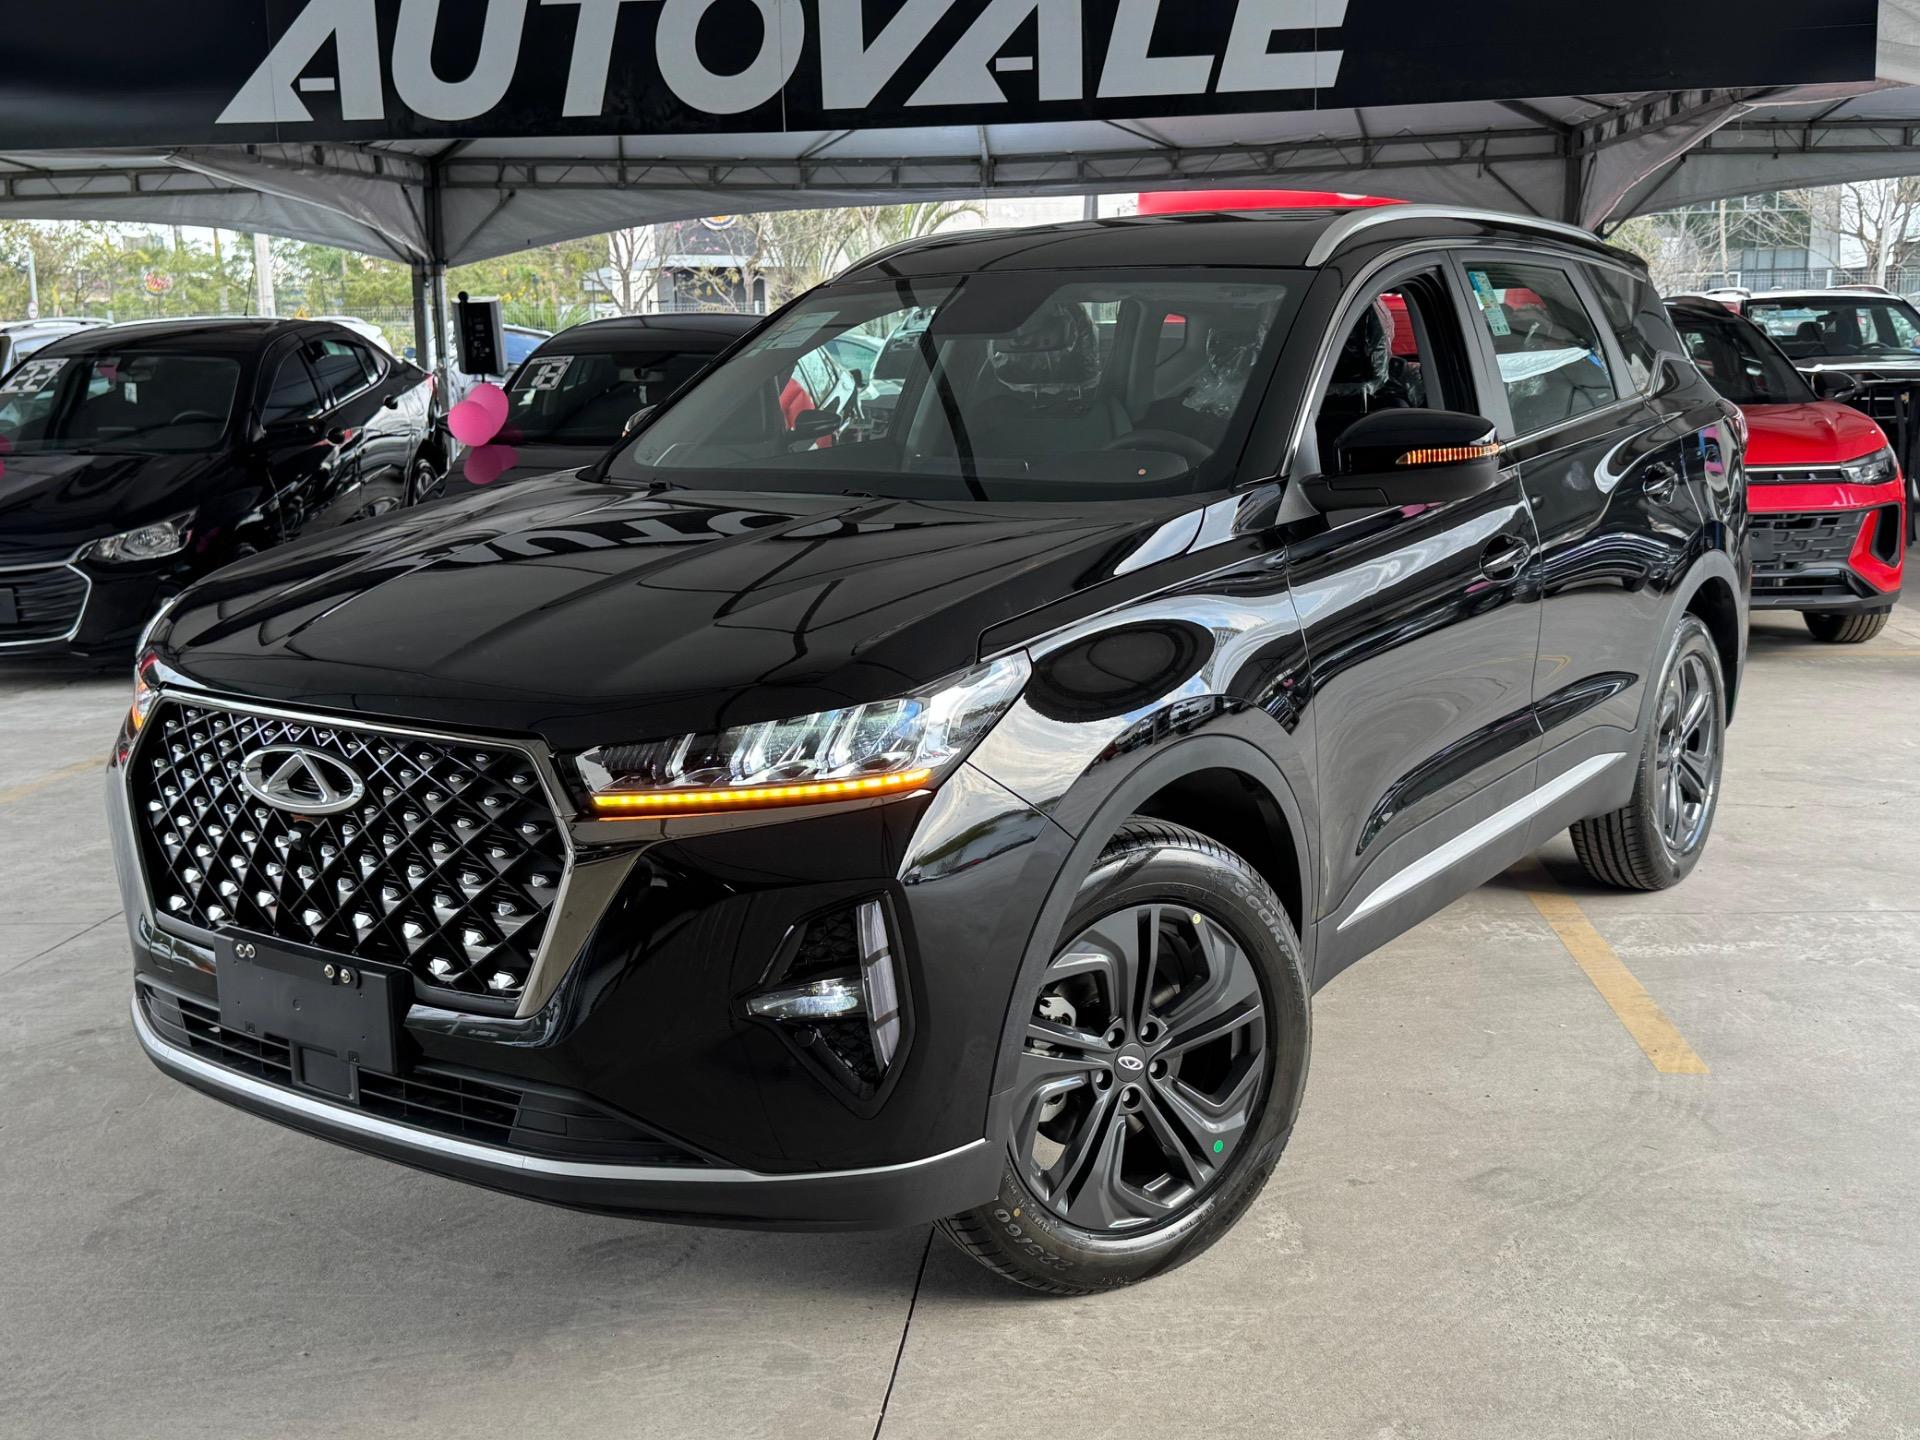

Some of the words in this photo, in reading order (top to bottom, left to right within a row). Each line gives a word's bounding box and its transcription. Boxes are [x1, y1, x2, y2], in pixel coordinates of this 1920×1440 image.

[216, 0, 1349, 125] AUTOVALE
[530, 362, 568, 389] 18
[992, 1207, 1076, 1272] 225/60
